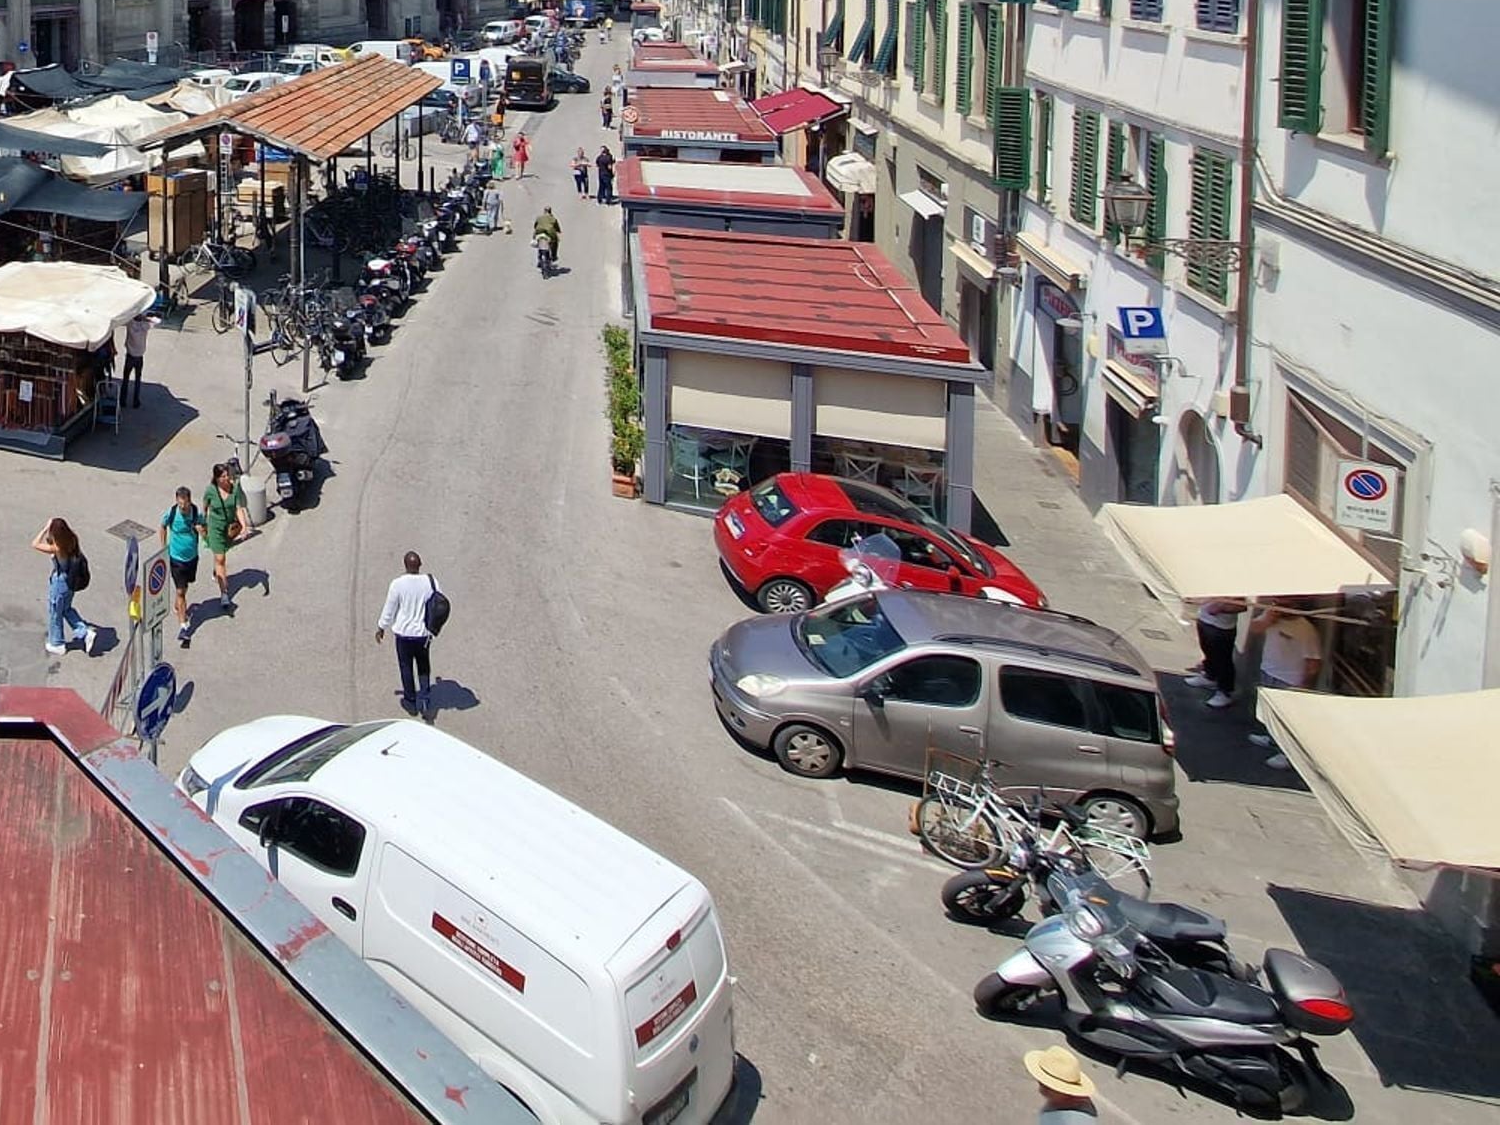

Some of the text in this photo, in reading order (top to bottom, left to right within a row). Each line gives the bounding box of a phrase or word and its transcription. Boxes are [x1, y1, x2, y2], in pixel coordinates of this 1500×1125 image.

[454, 61, 465, 75] P
[661, 129, 739, 142] RISTORANTE
[1126, 309, 1155, 336] P
